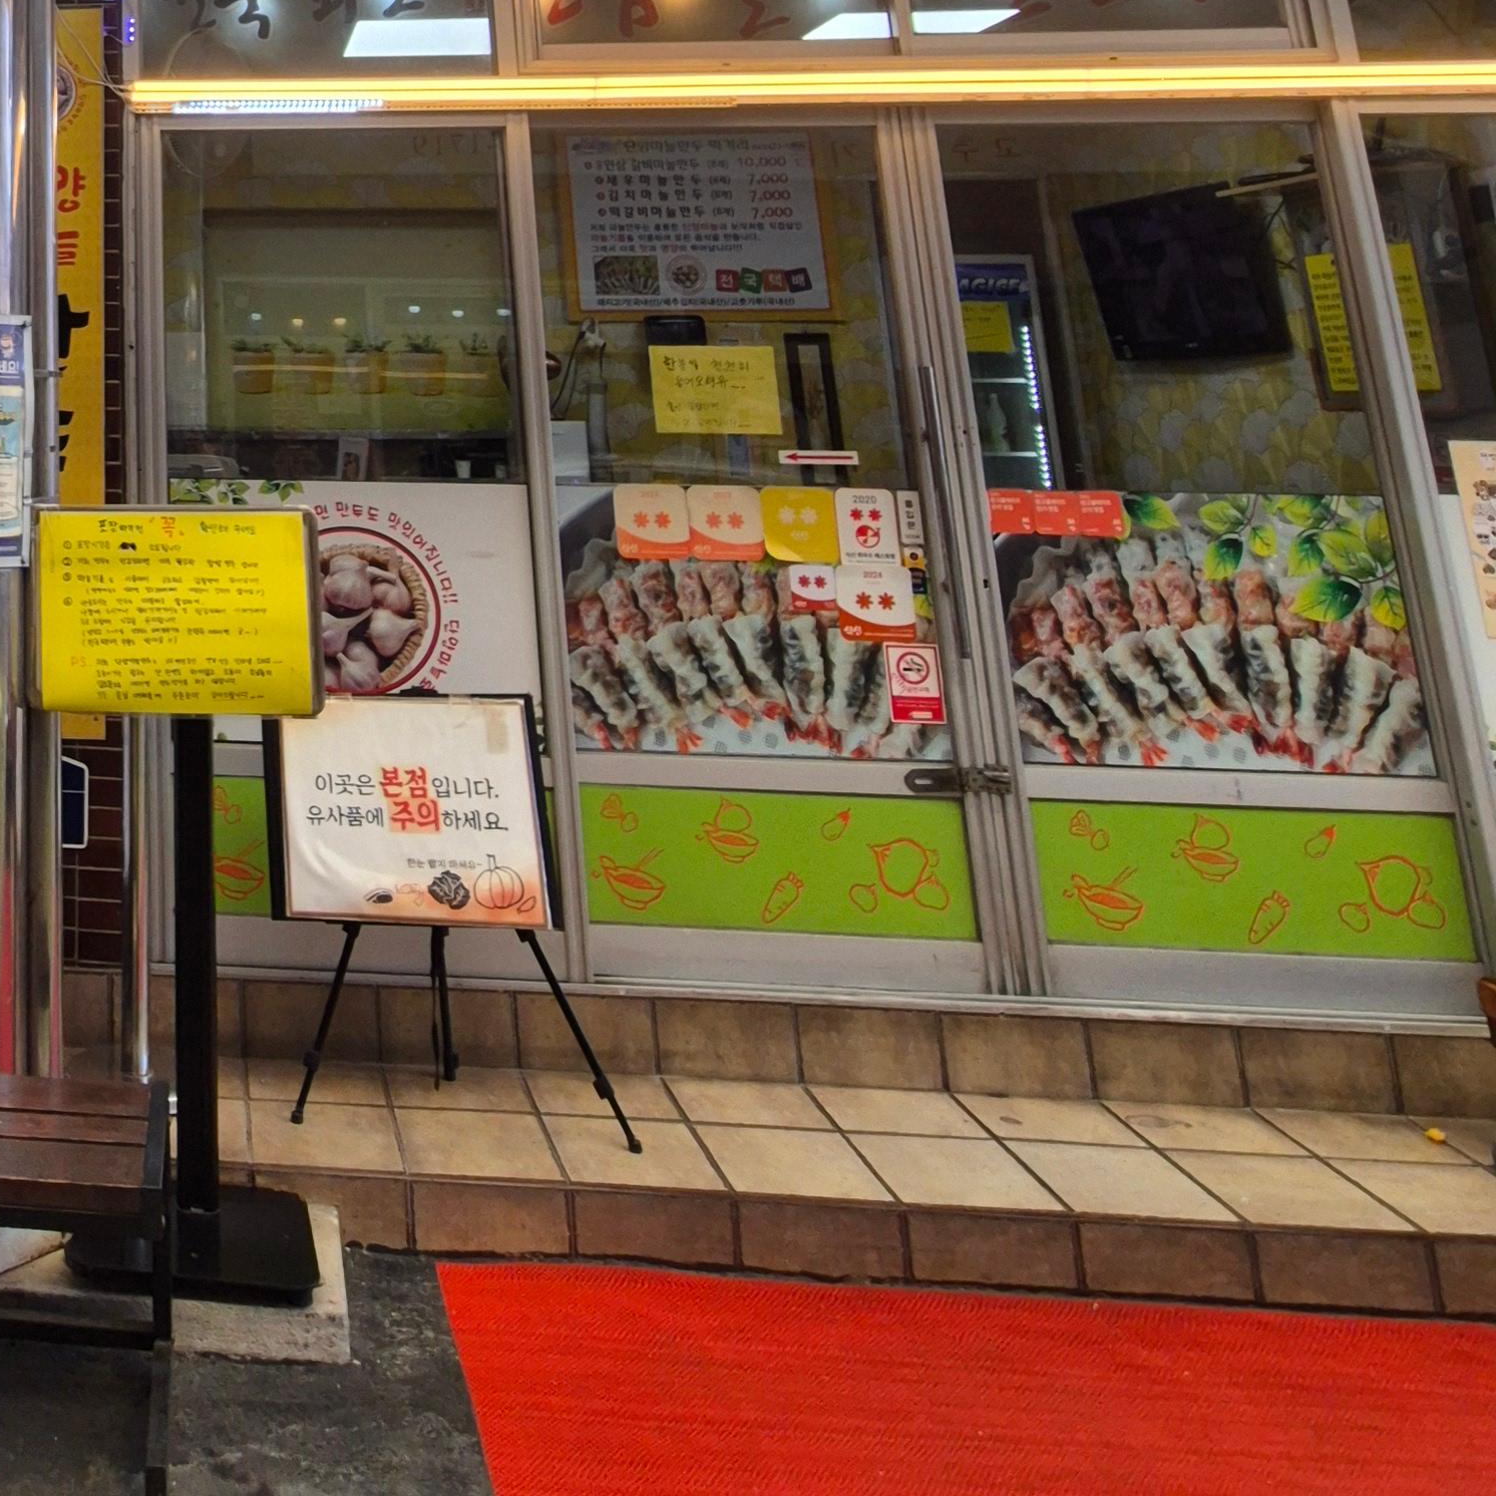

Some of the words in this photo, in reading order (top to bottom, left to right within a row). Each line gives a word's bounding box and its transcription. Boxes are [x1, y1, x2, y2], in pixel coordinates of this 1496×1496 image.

[749, 189, 792, 203] 7,000
[751, 206, 794, 220] 7,000
[314, 772, 376, 796] 이곳은
[306, 804, 384, 828] 유사품에
